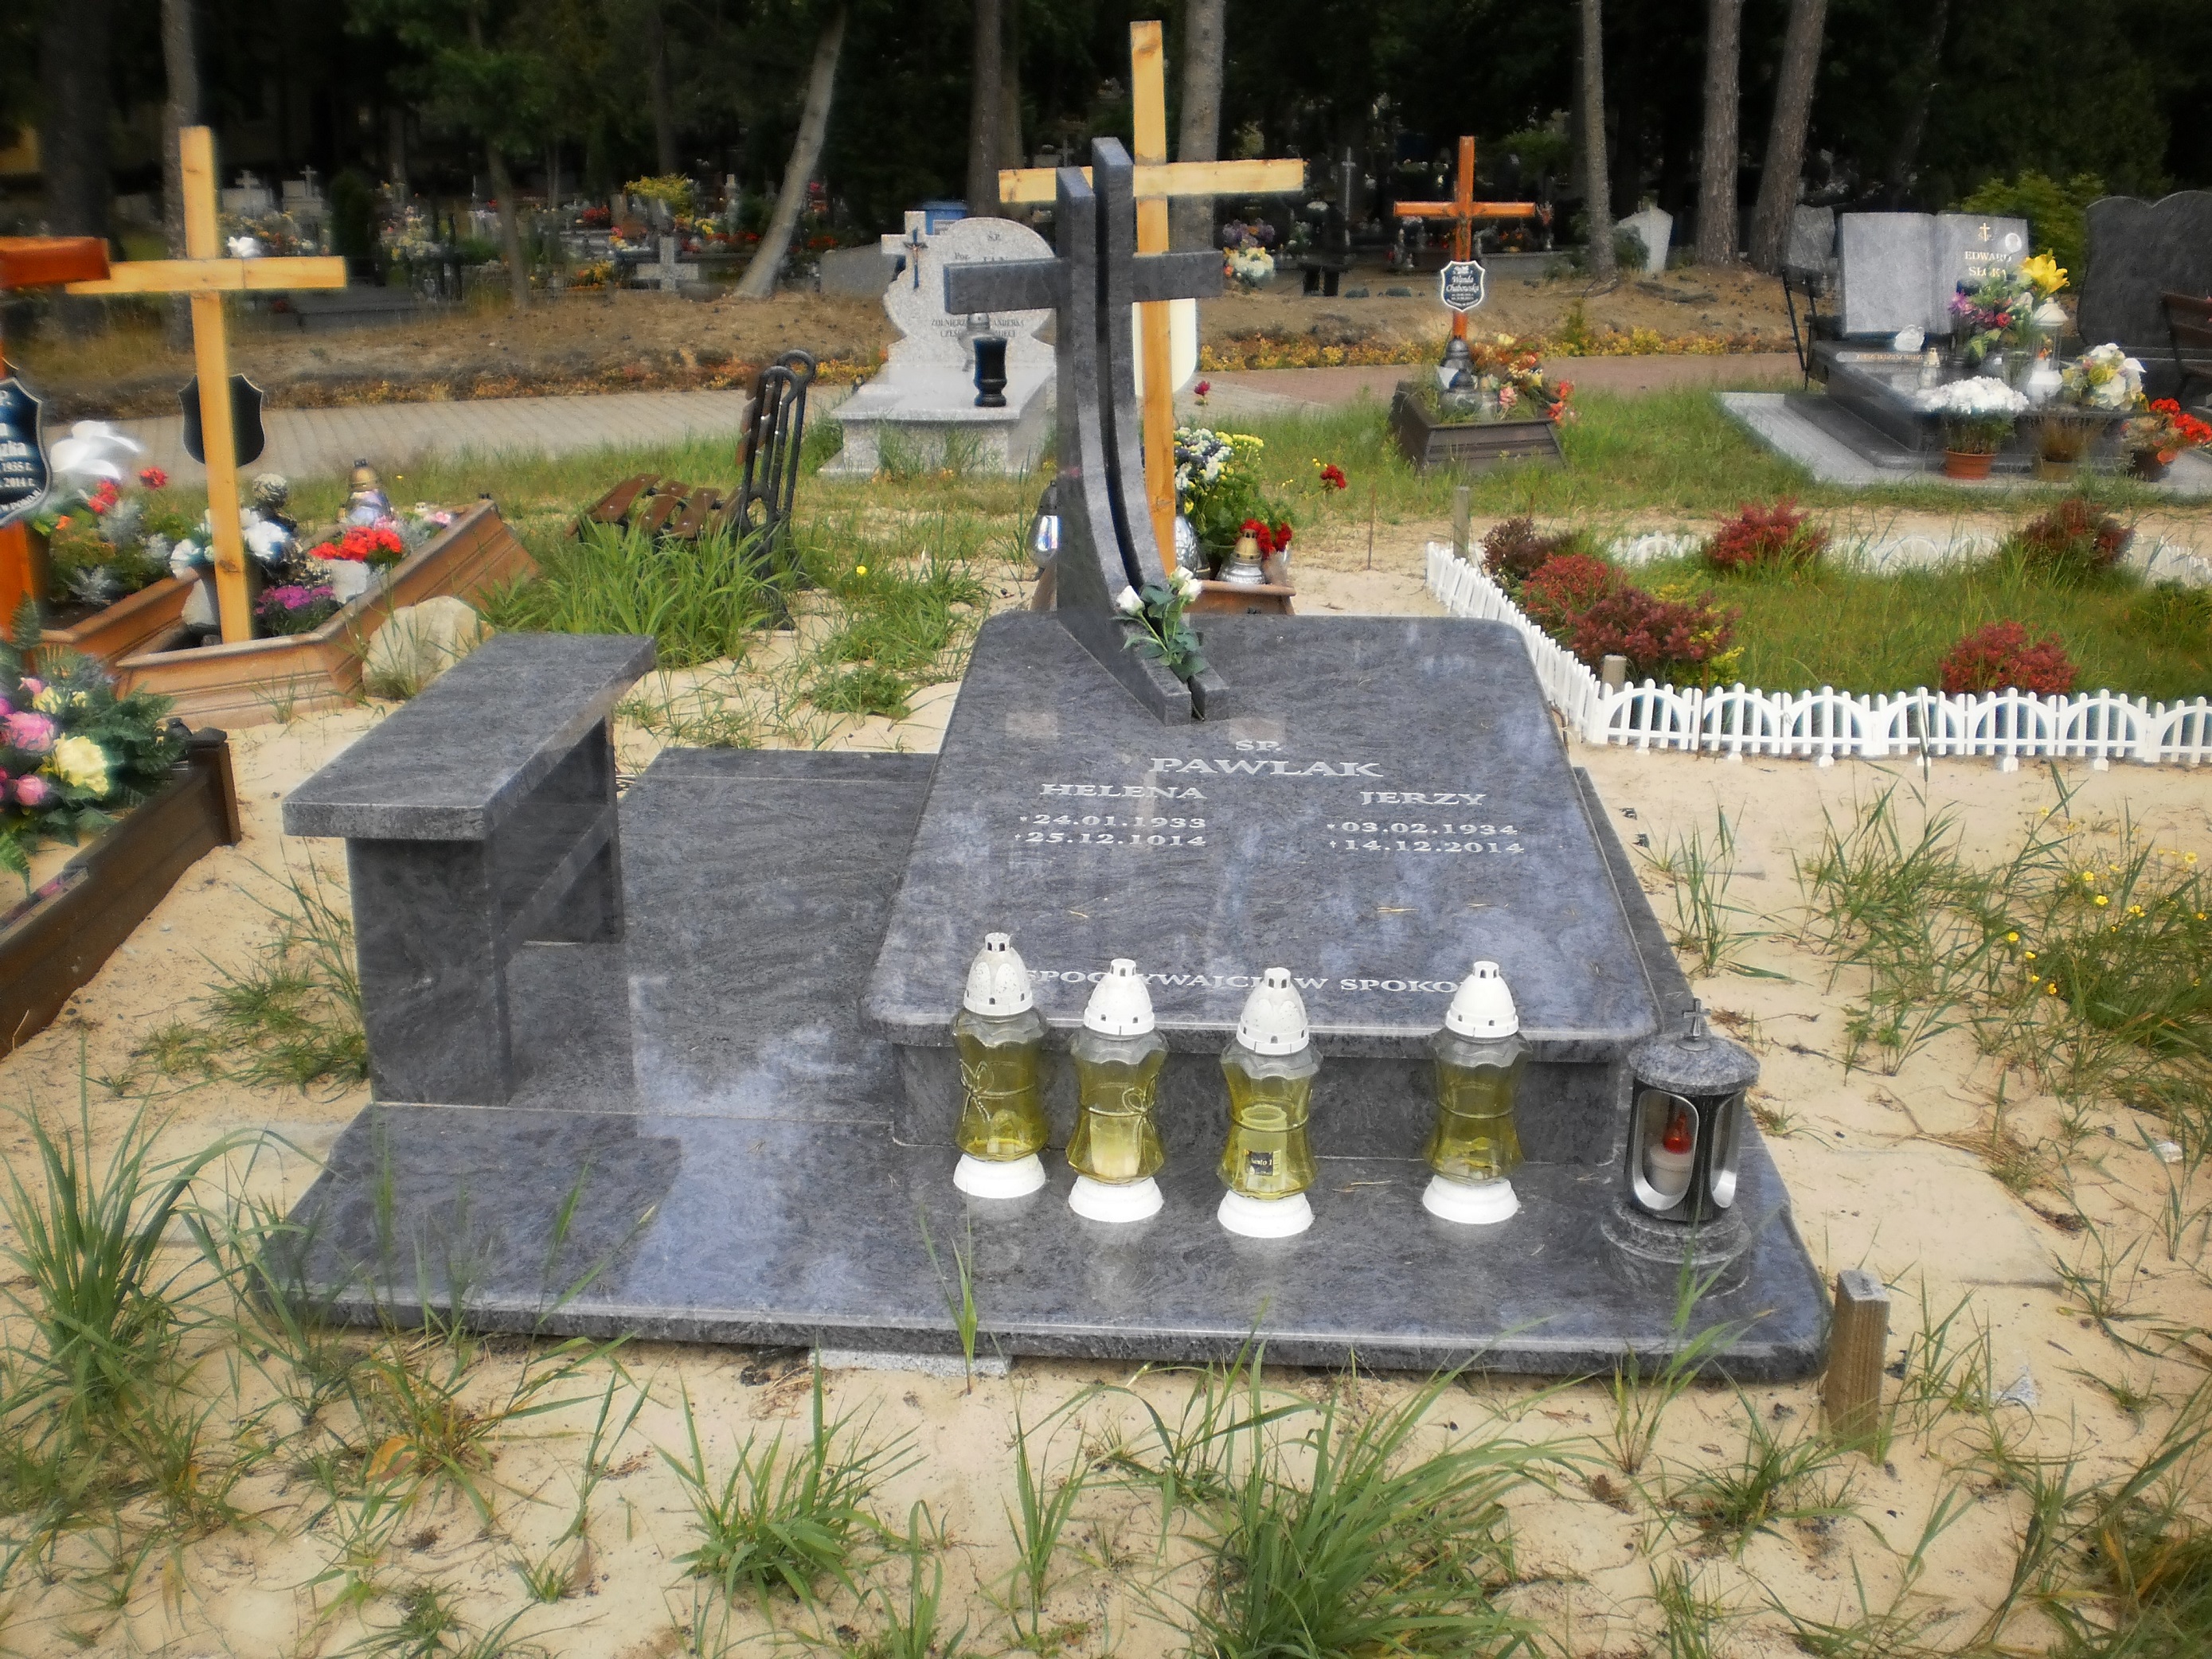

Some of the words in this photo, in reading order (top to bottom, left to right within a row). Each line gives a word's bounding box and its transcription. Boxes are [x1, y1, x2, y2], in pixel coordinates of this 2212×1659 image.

[1964, 251, 2011, 262] EDWARD
[1149, 757, 1384, 778] PAWLAK
[1040, 783, 1208, 799] HELENA
[1360, 791, 1487, 806] JERZY
[1294, 978, 1329, 990] W
